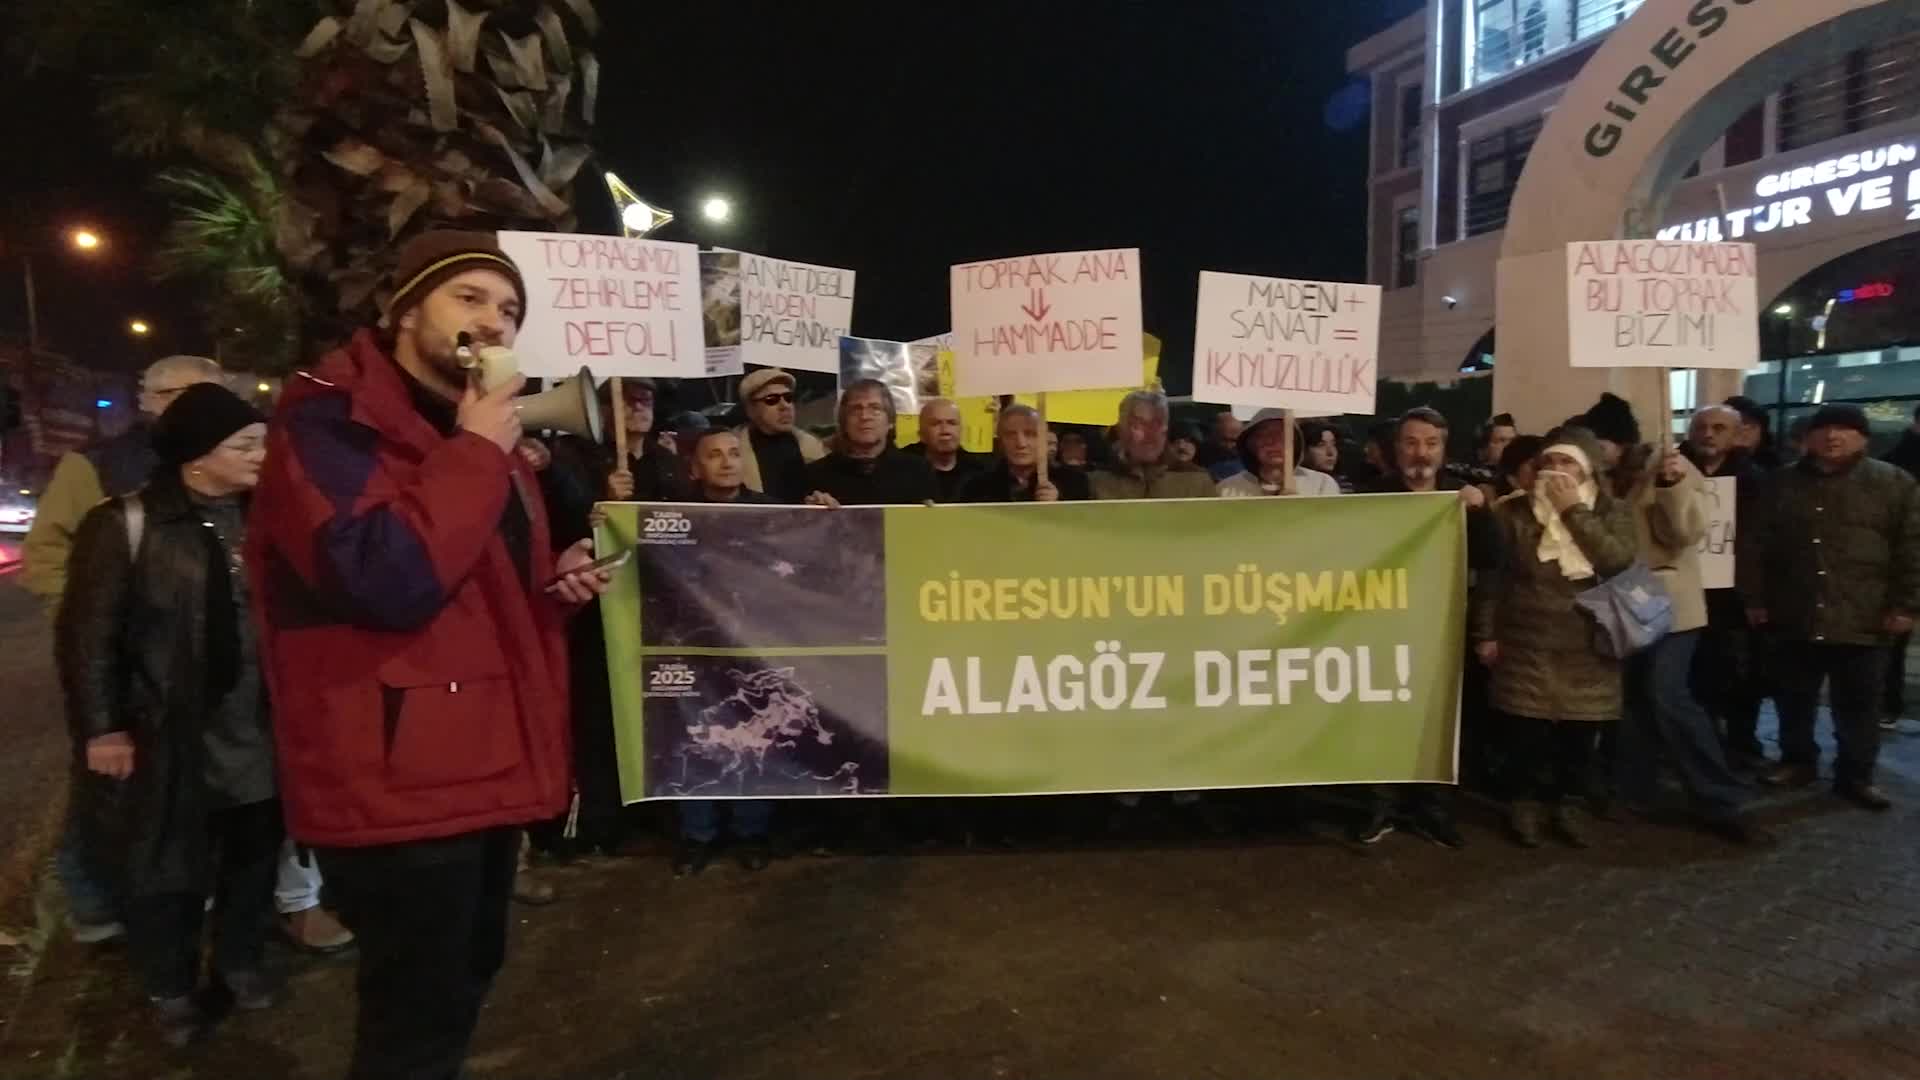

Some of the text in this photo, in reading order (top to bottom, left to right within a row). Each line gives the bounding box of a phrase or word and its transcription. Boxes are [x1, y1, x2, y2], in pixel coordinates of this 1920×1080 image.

[1584, 0, 1753, 158] GİRES
[1826, 175, 1894, 216] VE
[741, 257, 806, 292] ANAT
[960, 251, 1129, 292] TOPRAK ANA
[747, 288, 817, 320] MADEN
[1247, 281, 1338, 313] MADEN
[1586, 277, 1742, 316] BU TOPRAK
[973, 316, 1119, 357] HAMMADDE
[1230, 309, 1329, 345] SANAT
[643, 518, 692, 532] 2020
[919, 563, 1409, 624] GİRESUN'UN DÜŞMANI
[650, 670, 697, 685] 2025
[921, 640, 1412, 716] ALAGÖZ DEFOL!
